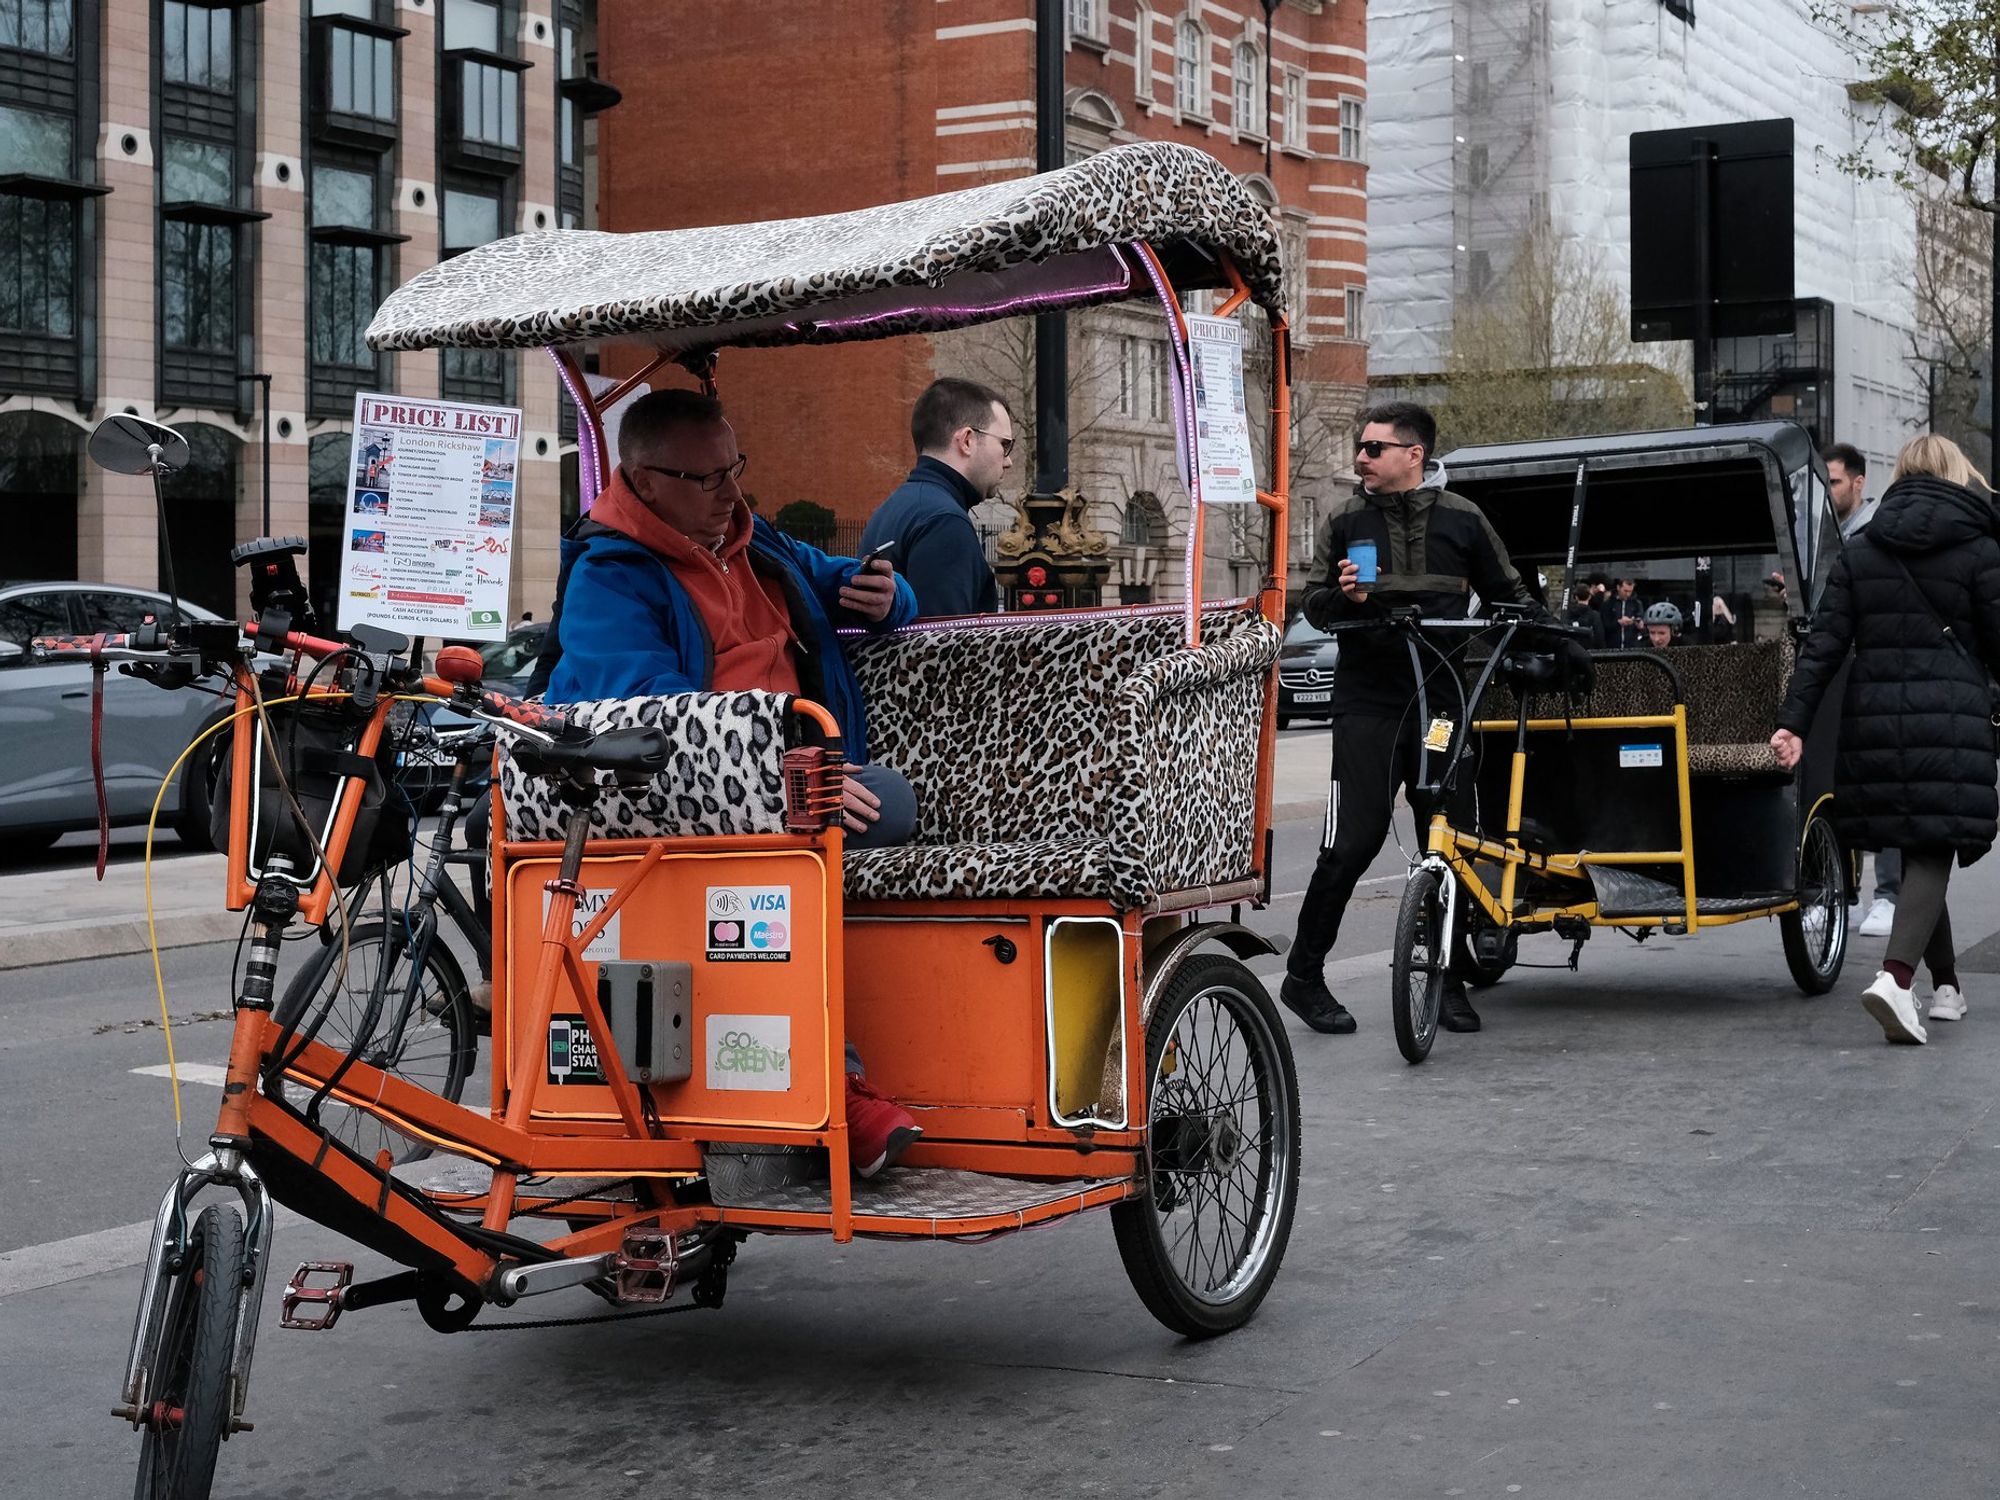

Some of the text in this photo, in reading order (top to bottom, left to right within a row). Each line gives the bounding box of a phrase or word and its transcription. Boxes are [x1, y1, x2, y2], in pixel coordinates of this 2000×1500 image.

[1194, 322, 1236, 341] PRICE LIST
[373, 404, 507, 434] PRICE LIST
[400, 437, 481, 452] London Rickshaw
[478, 574, 503, 586] Harrods
[750, 894, 786, 910] VISA
[754, 931, 784, 939] Maestro
[572, 1029, 594, 1044] PH
[725, 1031, 752, 1049] GO
[572, 1045, 597, 1054] CHAR
[572, 1055, 598, 1067] STAT
[717, 1046, 778, 1072] GREEN
